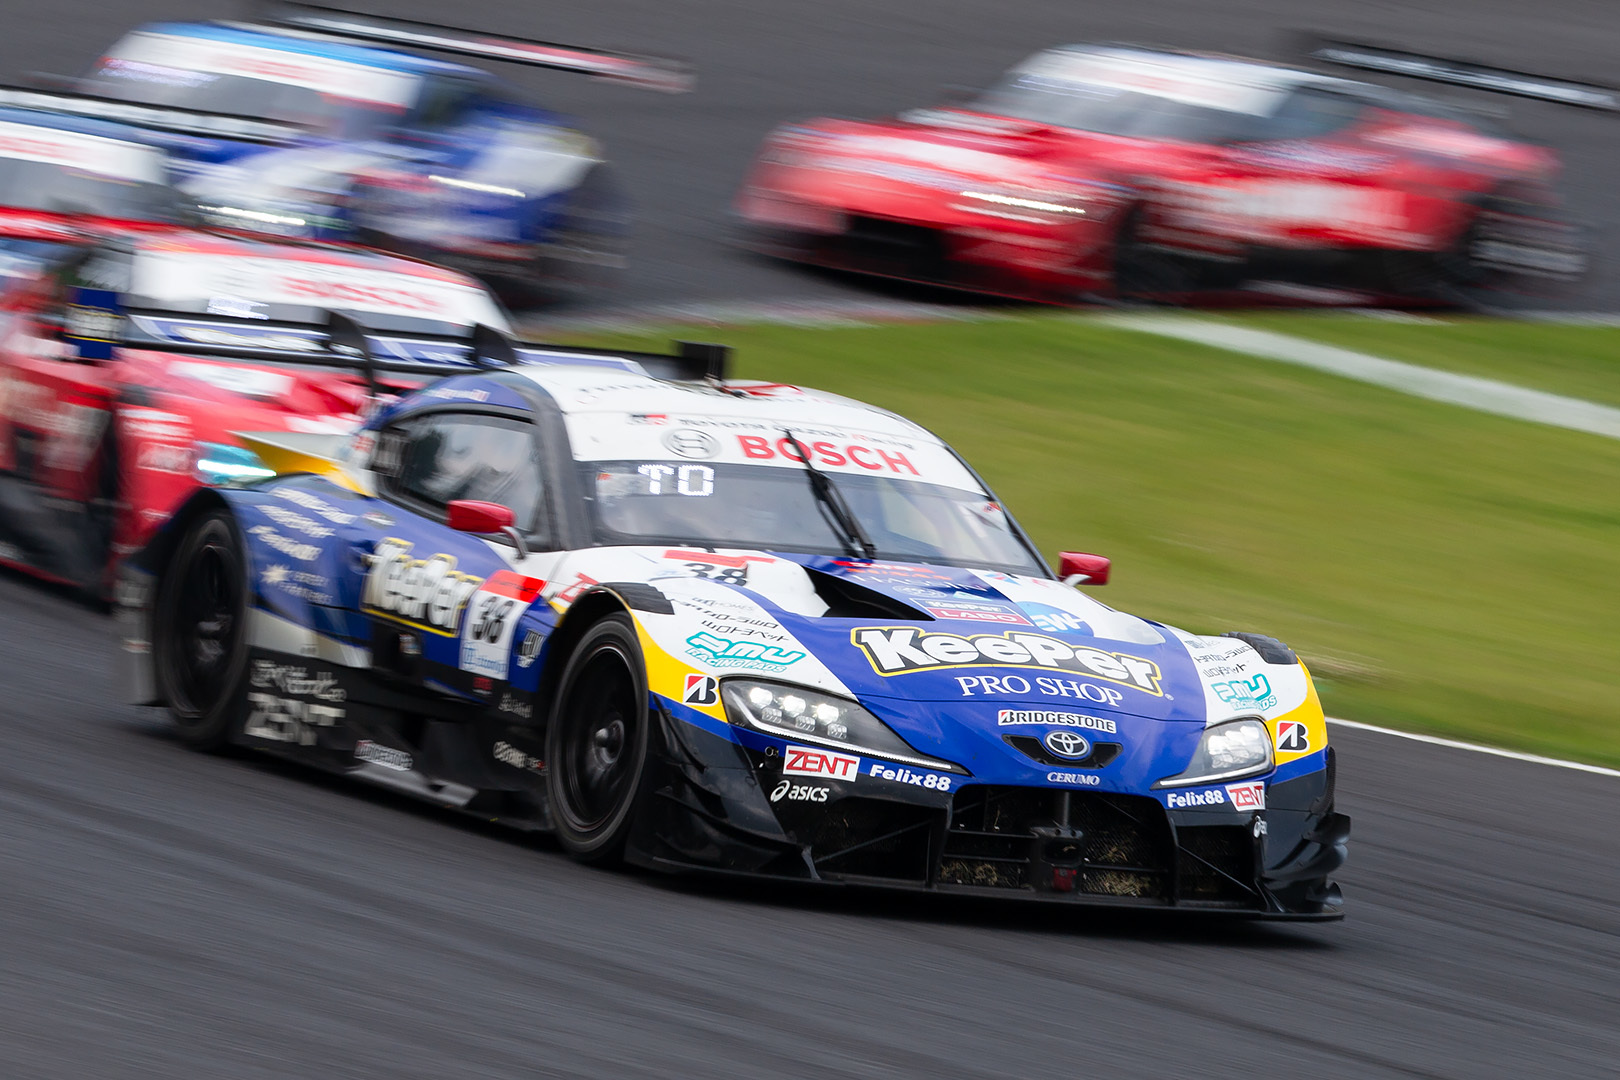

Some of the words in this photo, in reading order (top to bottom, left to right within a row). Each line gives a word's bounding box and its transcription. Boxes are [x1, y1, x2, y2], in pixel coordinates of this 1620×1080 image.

[736, 434, 921, 477] BOSCH
[684, 562, 749, 587] 38
[939, 610, 1019, 623] LABO
[685, 647, 744, 669] RACING
[858, 627, 1158, 692] KeePer
[955, 675, 1031, 697] PRO
[1035, 676, 1123, 708] SHOP
[998, 710, 1117, 733] BRIDGESTONE
[785, 748, 857, 778] ZENT
[869, 763, 952, 791] Felix88
[1046, 771, 1100, 785] CERUMO
[1167, 789, 1225, 808] Felix88
[1228, 785, 1265, 807] ZENT
